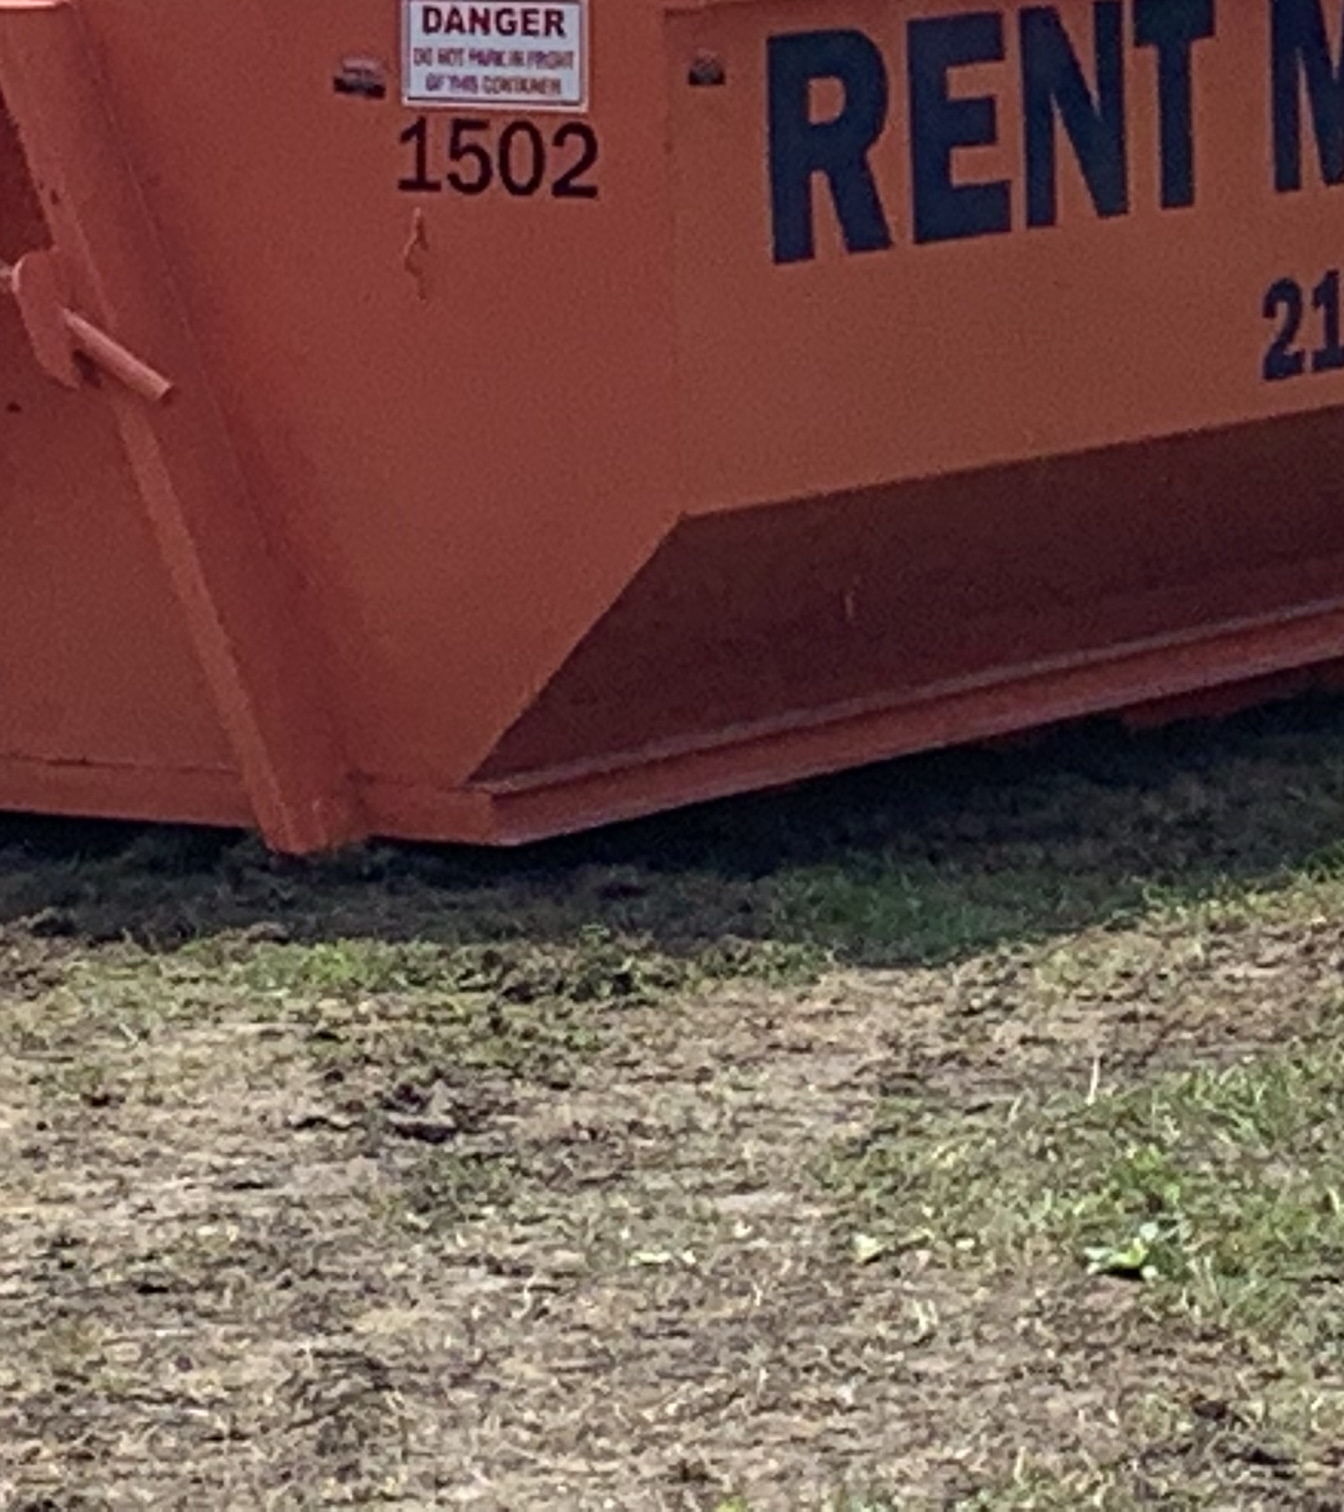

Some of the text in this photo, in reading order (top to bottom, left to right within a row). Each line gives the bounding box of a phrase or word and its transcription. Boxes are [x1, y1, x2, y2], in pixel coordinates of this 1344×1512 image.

[422, 6, 566, 37] DANGER
[413, 47, 433, 67] DO
[438, 48, 465, 67] NOT
[469, 49, 505, 67] PARK
[397, 116, 598, 199] 1502
